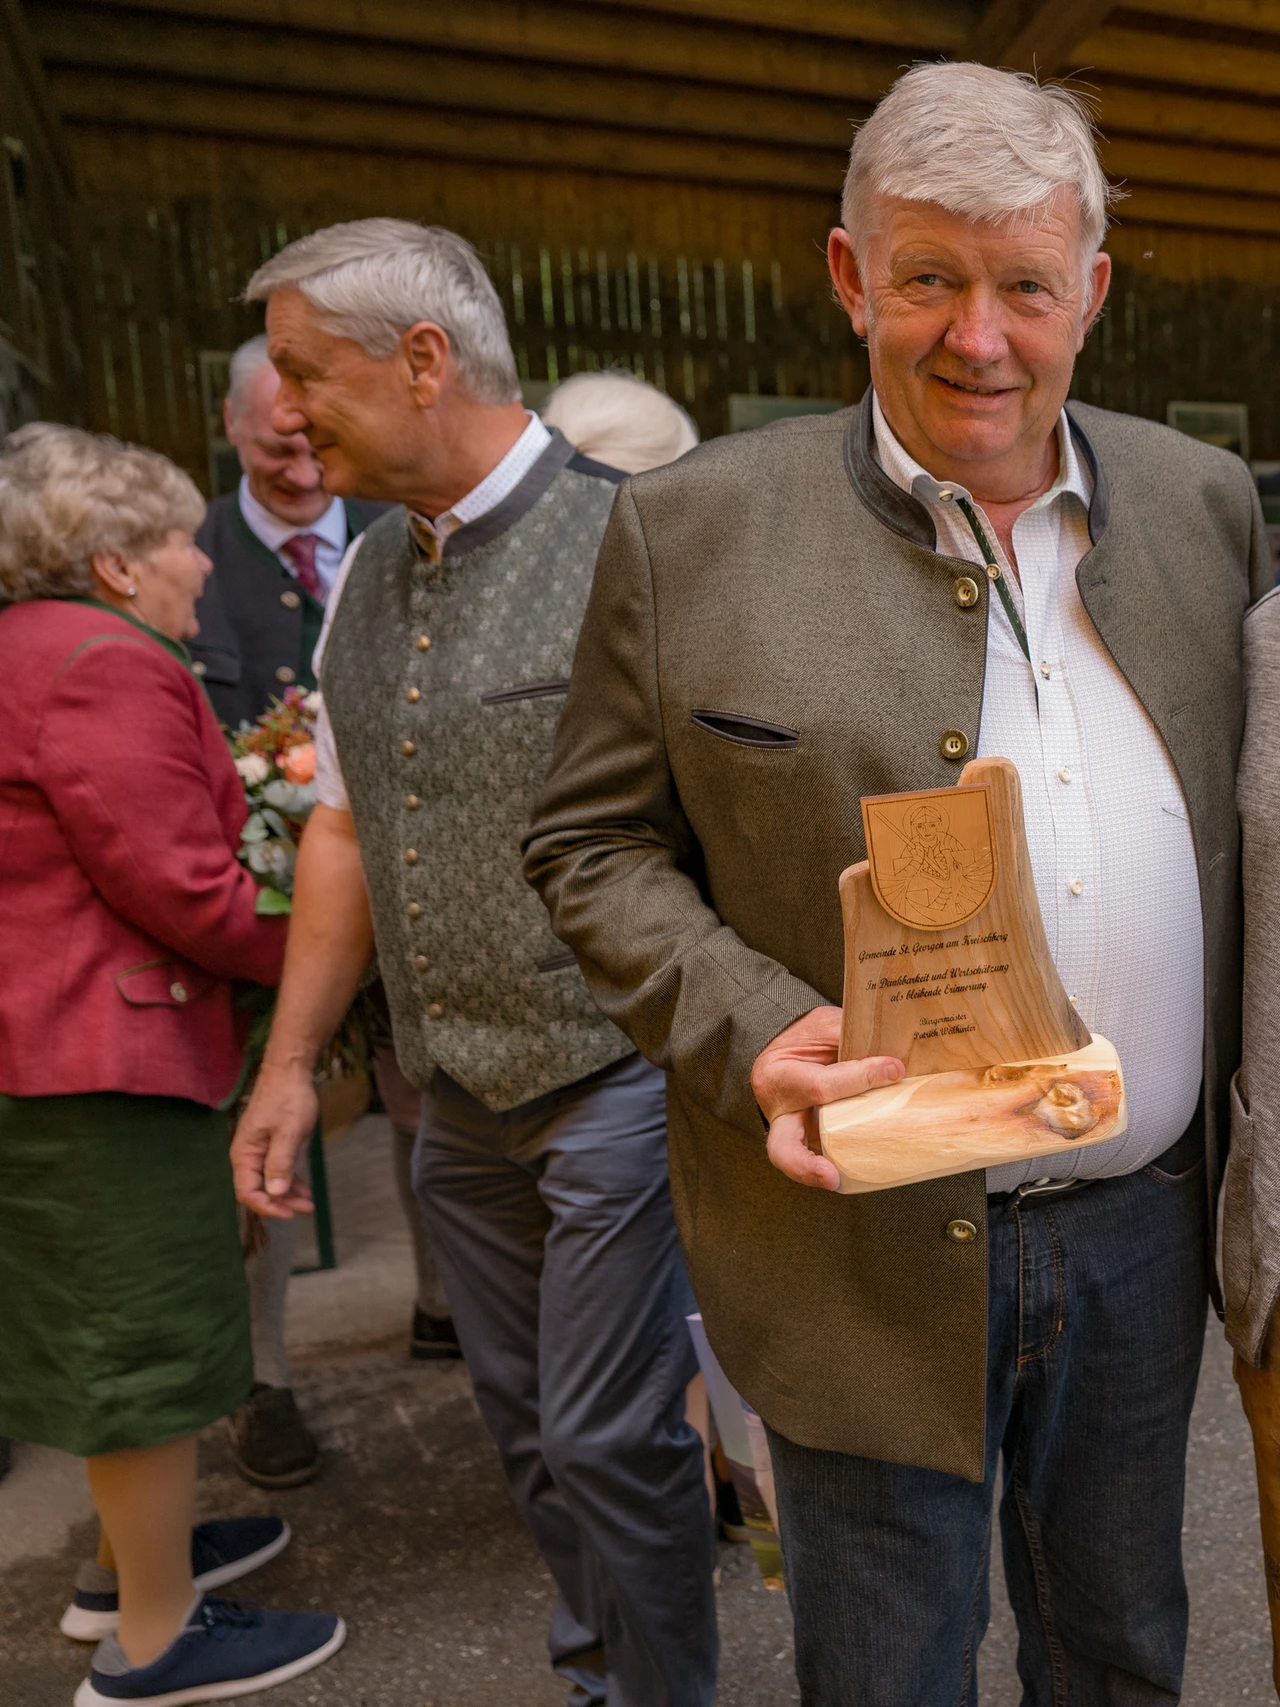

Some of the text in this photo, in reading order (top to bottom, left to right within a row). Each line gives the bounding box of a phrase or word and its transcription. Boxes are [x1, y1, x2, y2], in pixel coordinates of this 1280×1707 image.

[858, 947, 896, 964] Gemeinde
[899, 944, 909, 955] St.
[912, 942, 944, 956] Georgen
[961, 932, 1008, 947] Kreischberg
[866, 963, 1009, 990] In Dankbarkeit und Wertschätzung
[891, 991, 903, 1002] als
[906, 985, 941, 1000] bleibende
[920, 1013, 967, 1026] Bürgermeister
[913, 1030, 938, 1040] Patrick
